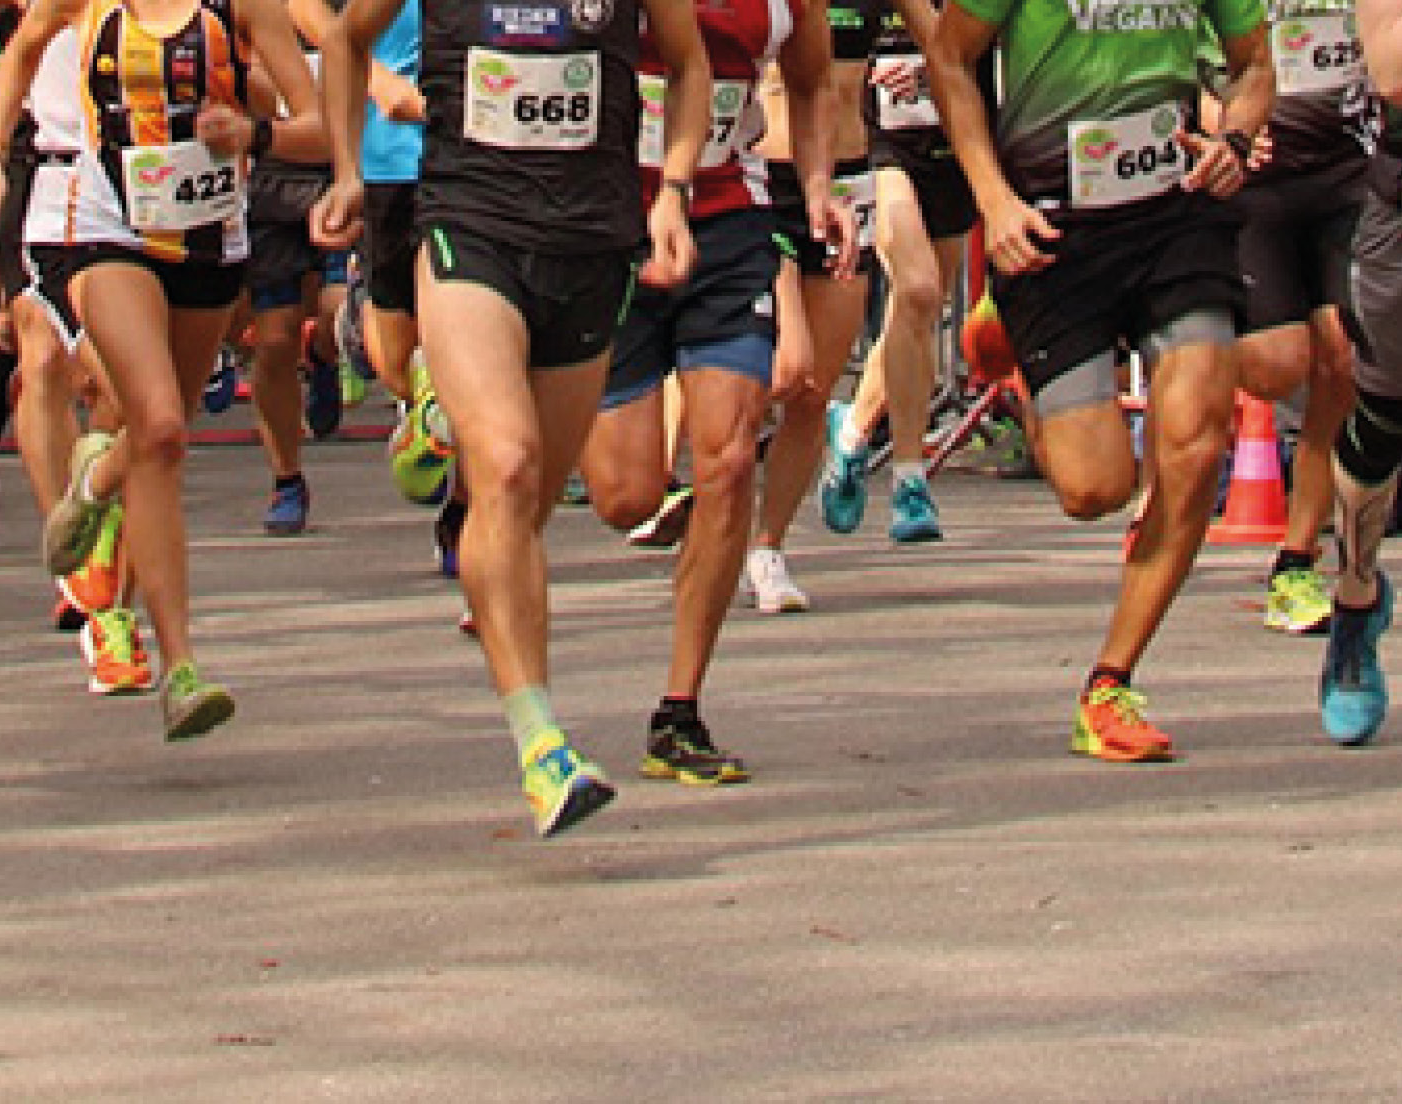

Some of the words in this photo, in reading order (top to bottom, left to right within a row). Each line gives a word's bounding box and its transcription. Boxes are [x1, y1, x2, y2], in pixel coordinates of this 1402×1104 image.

[513, 92, 590, 126] 668
[1113, 137, 1177, 180] 604
[174, 166, 236, 205] 422
